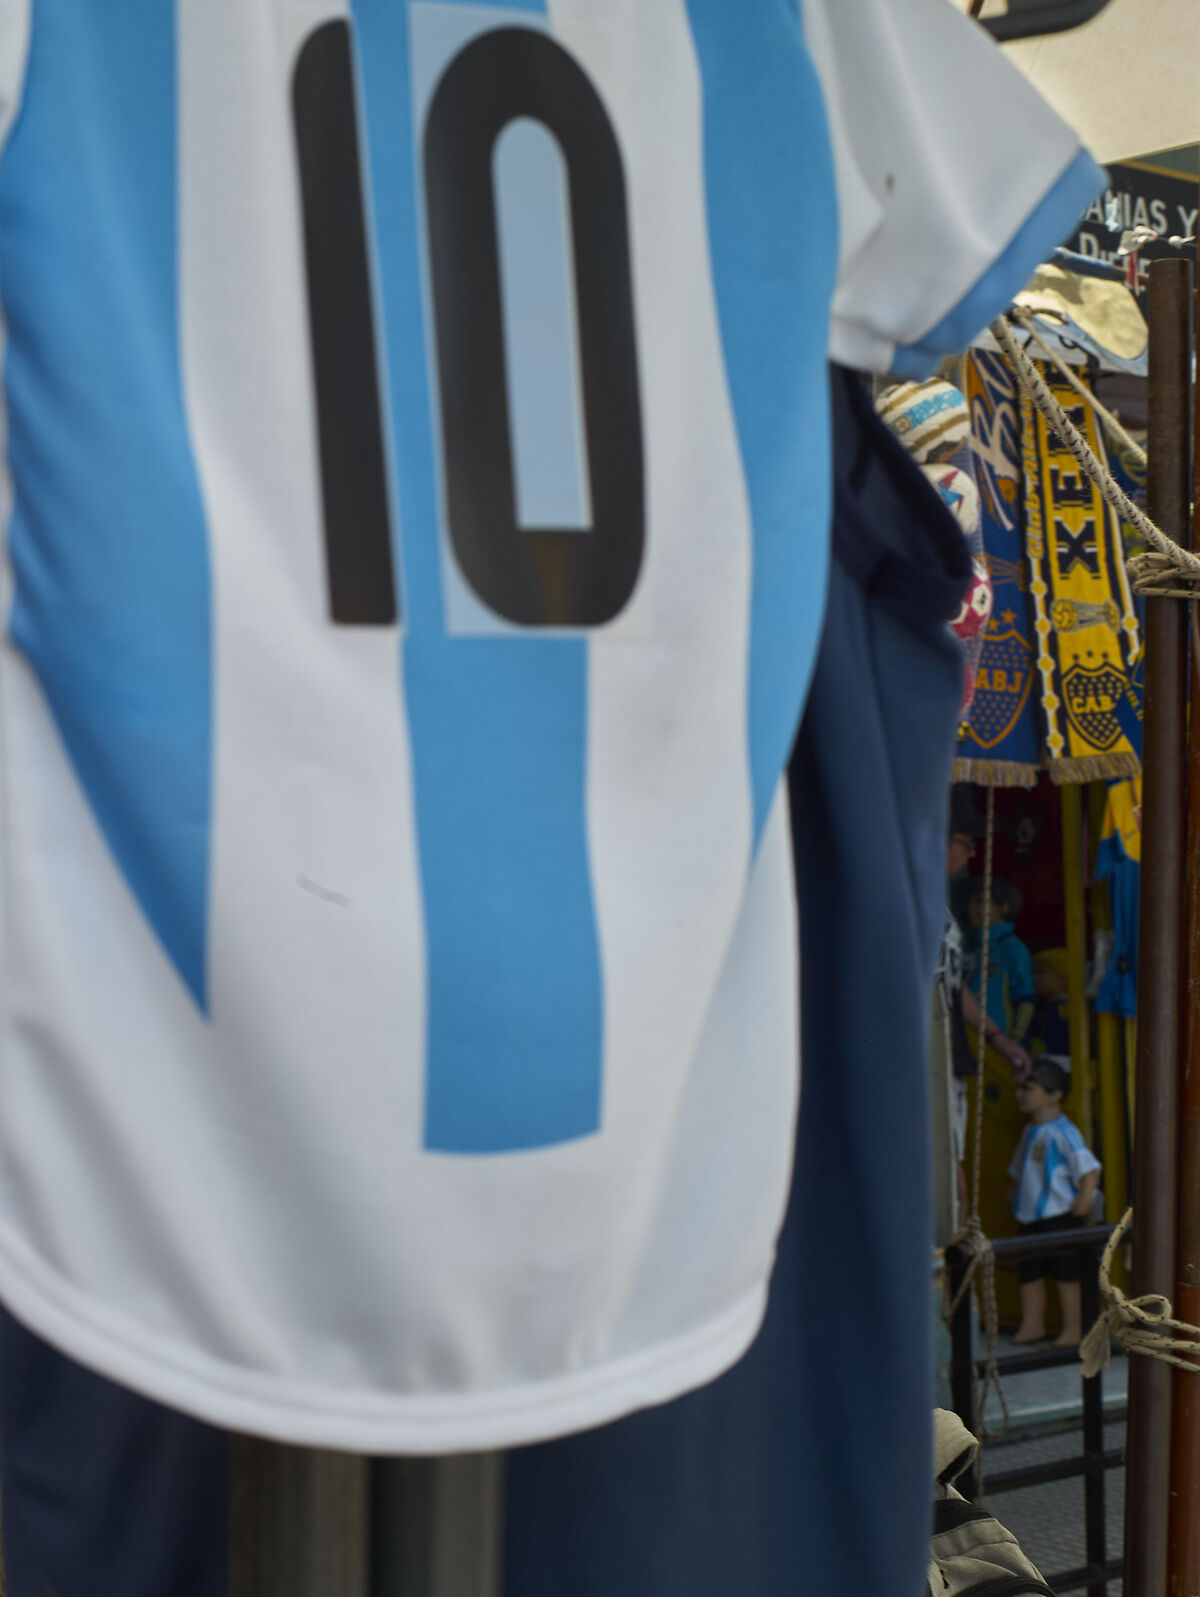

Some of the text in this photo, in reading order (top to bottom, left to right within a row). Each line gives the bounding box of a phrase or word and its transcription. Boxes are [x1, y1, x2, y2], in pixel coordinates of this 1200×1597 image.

[1083, 188, 1199, 240] ANIAS Y
[290, 17, 648, 628] 10
[976, 666, 1025, 692] ABJ
[1071, 694, 1114, 713] CAB
